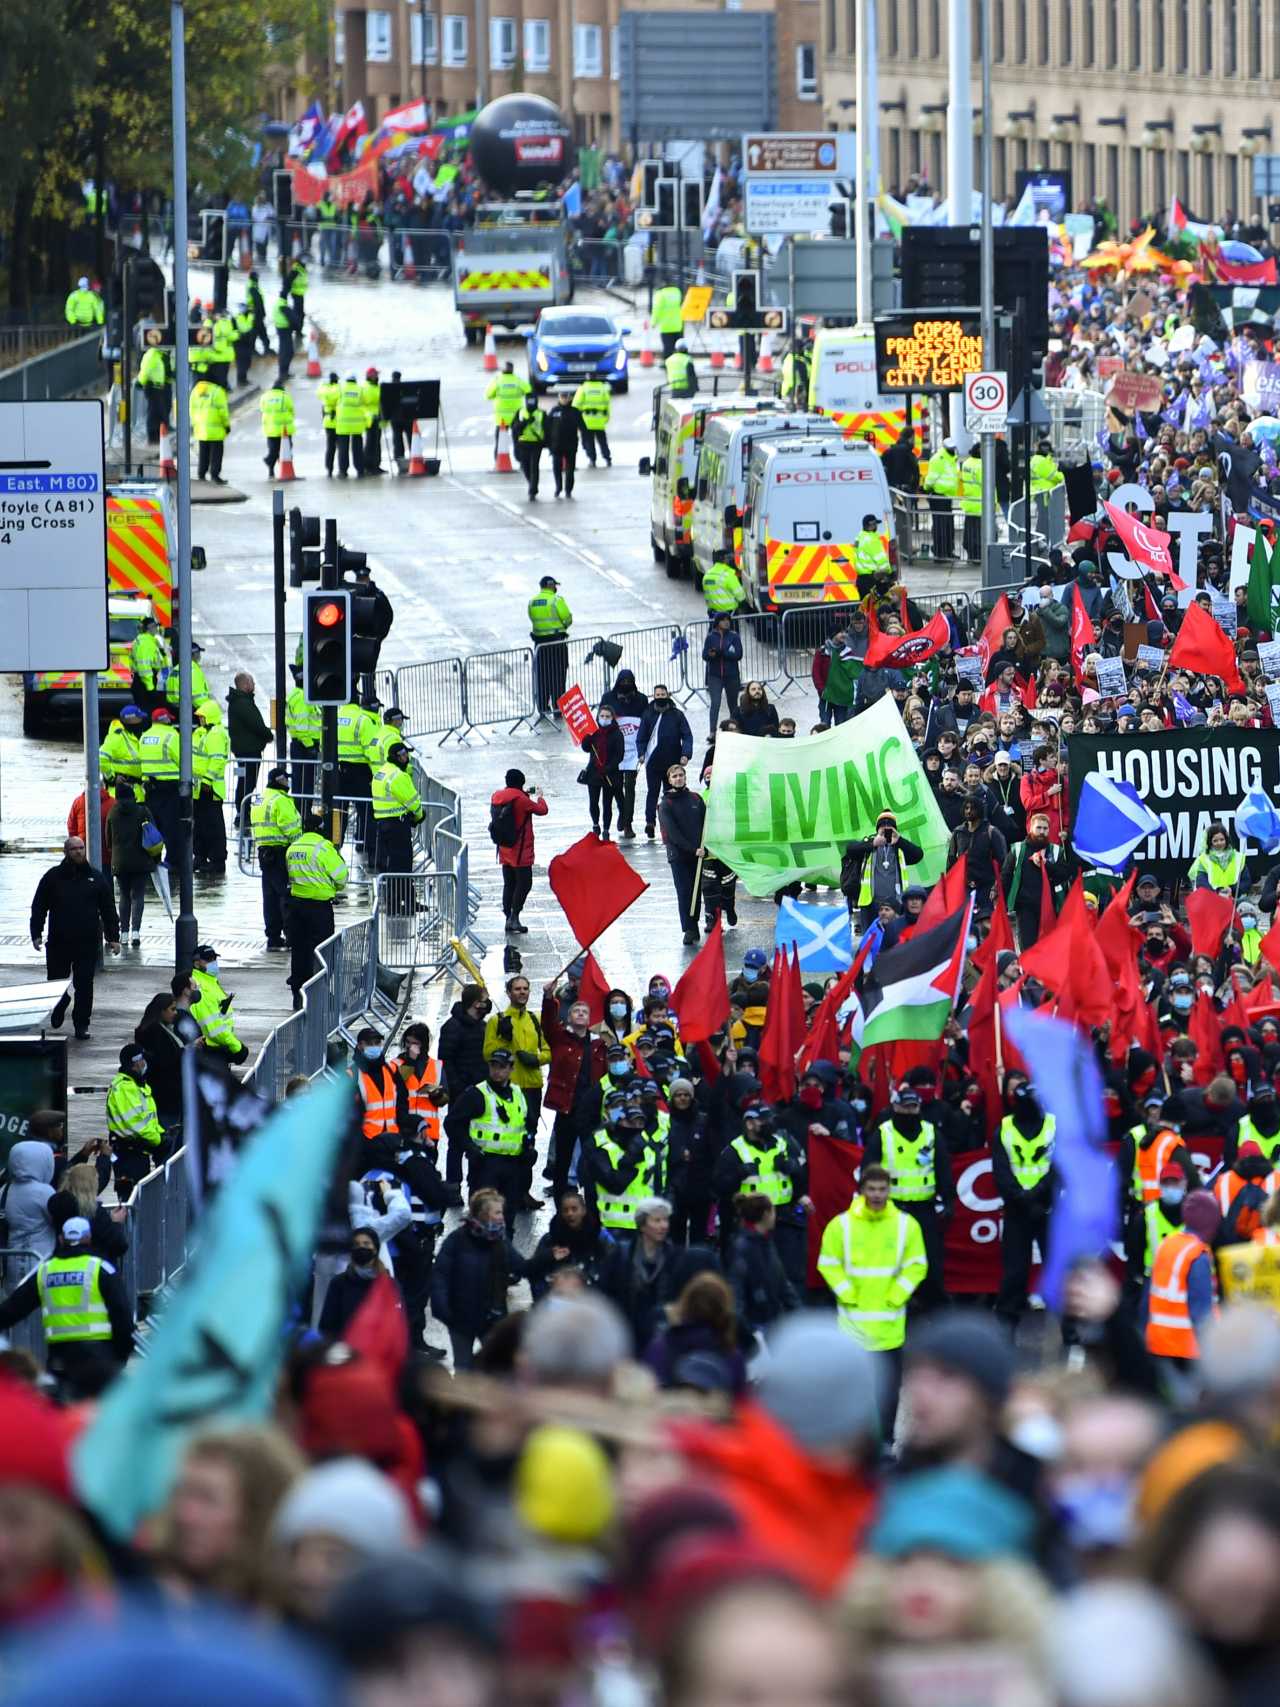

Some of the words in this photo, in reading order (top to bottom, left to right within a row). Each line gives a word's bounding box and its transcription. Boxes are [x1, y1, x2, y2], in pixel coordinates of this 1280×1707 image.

[914, 321, 963, 338] COP26
[886, 336, 983, 355] PROCESSION
[834, 361, 877, 374] POLI
[886, 370, 928, 386] CITY
[931, 368, 982, 386] CEN
[974, 386, 999, 401] 30
[7, 476, 44, 491] East,
[776, 469, 874, 485] POLICE
[31, 516, 75, 529] Cross
[1097, 746, 1262, 799] HOUSING
[734, 736, 920, 842] LIVING
[47, 1272, 85, 1288] POLICE
